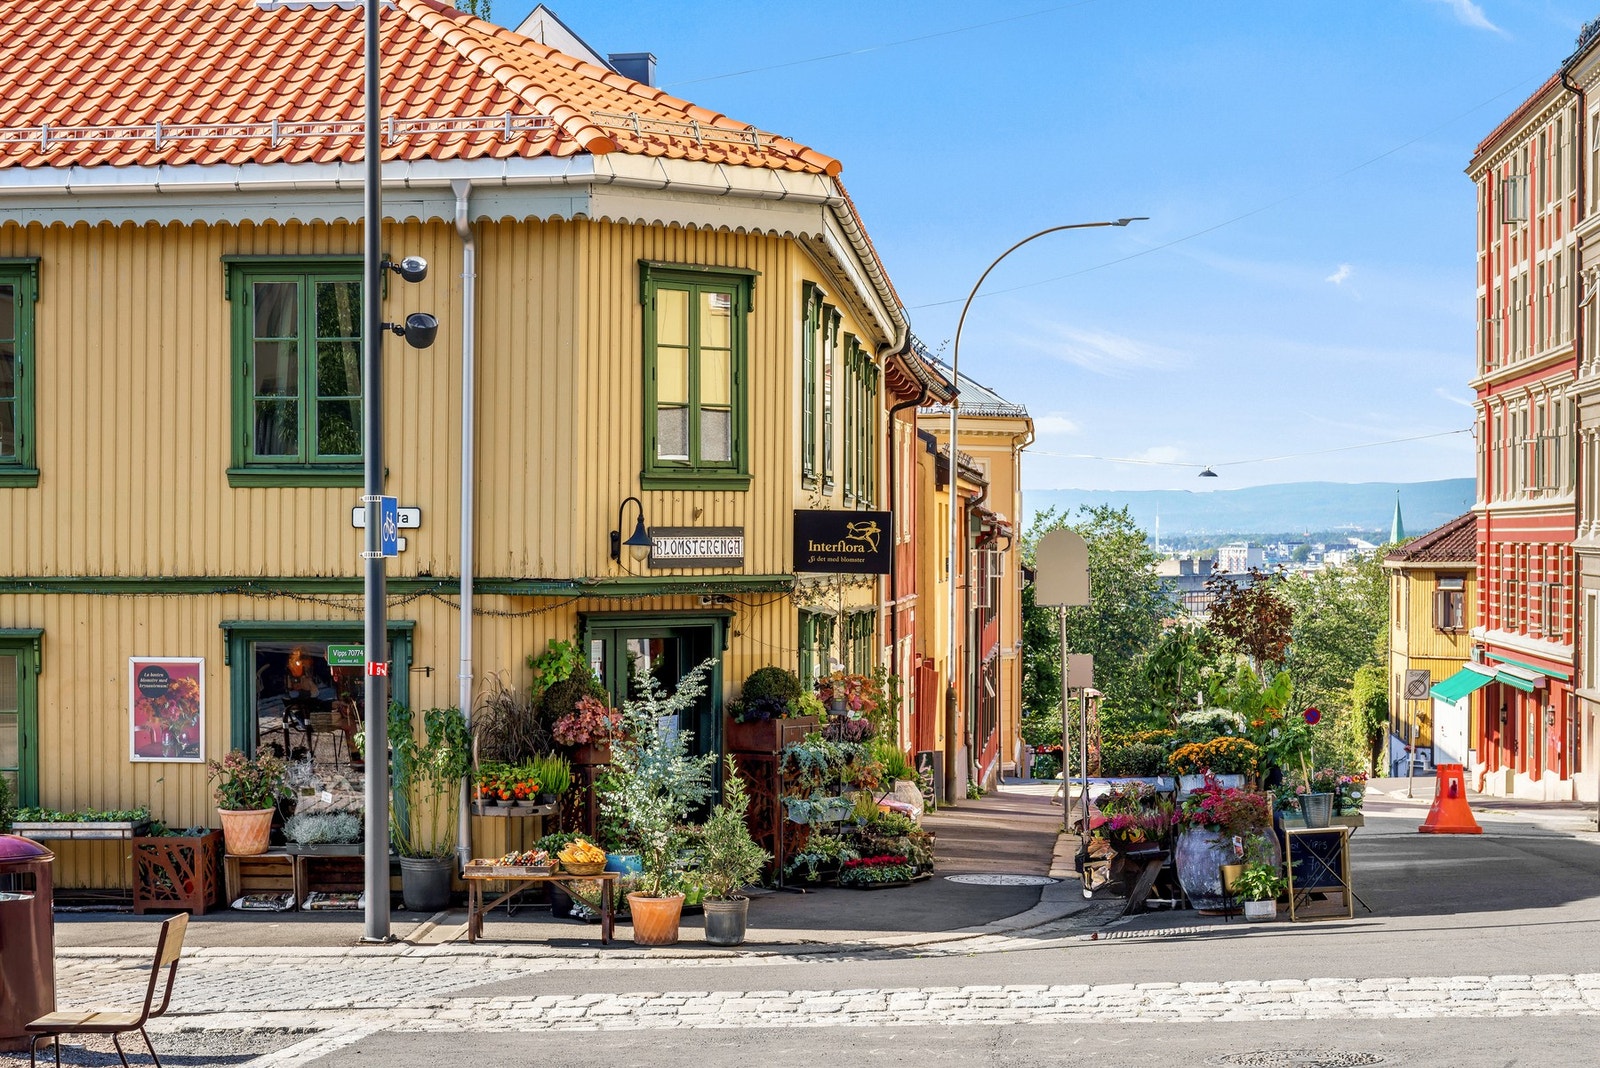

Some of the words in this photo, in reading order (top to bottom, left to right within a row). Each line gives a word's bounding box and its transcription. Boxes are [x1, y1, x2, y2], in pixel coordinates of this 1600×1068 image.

[656, 540, 741, 555] BLOMSTERENGA
[808, 540, 865, 553] Interflora
[333, 649, 347, 657] Vipps
